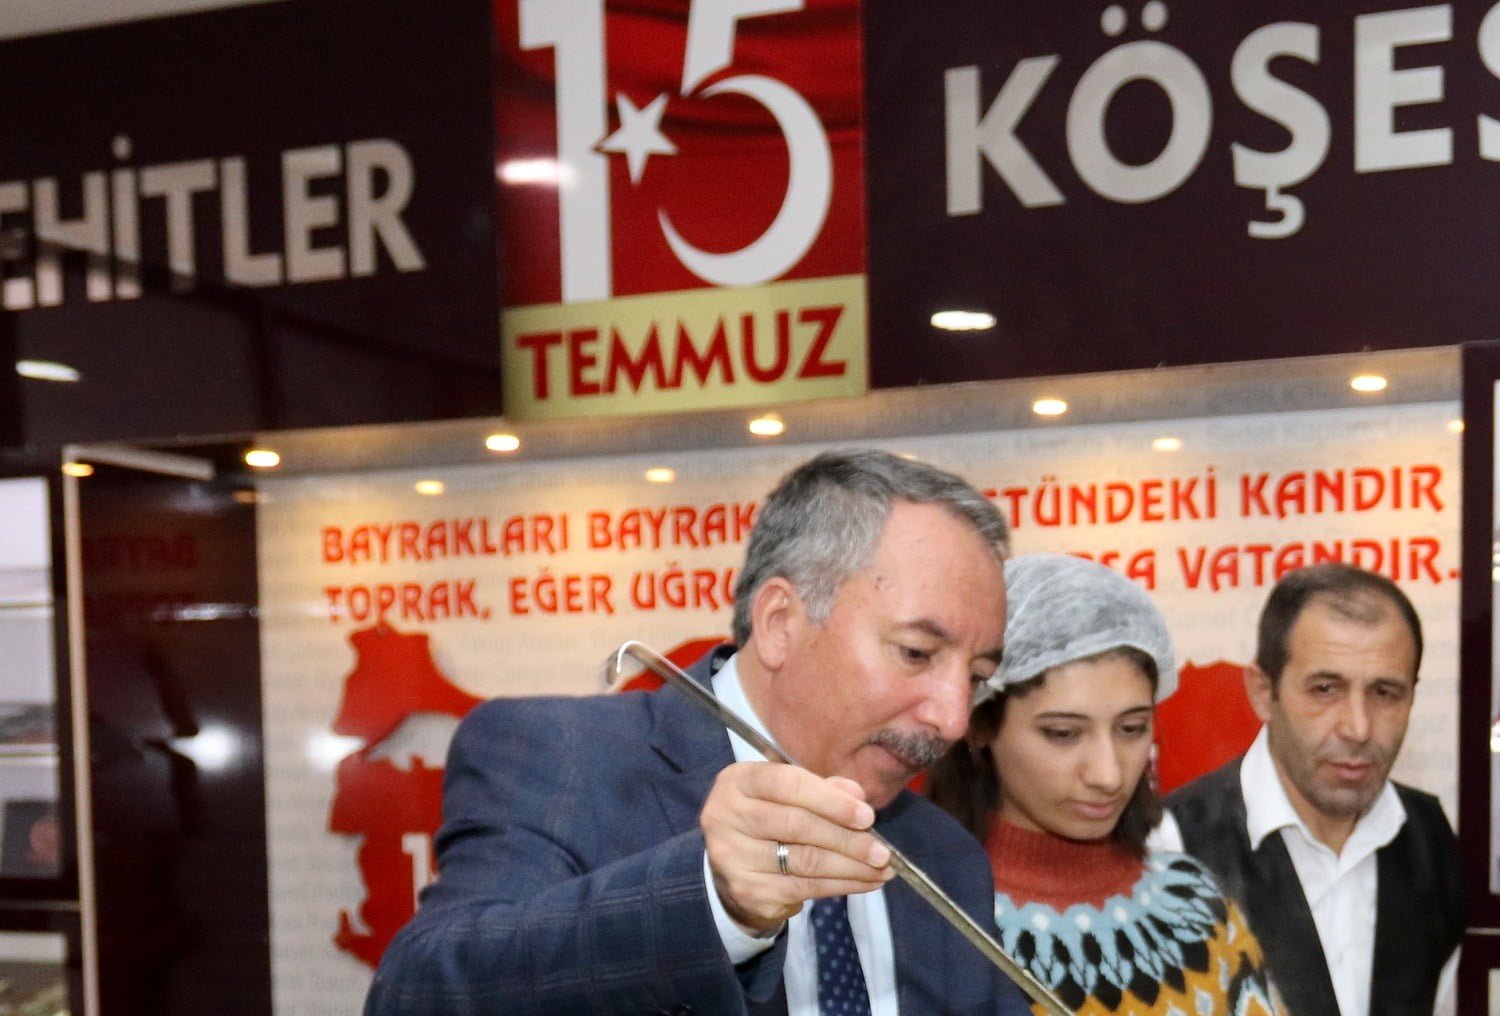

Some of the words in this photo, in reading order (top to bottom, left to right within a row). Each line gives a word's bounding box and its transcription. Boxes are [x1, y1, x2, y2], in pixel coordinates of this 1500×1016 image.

[517, 306, 847, 399] TEMMUZ
[321, 513, 569, 564] BAYRAKLARI
[984, 476, 1217, 529] TÜNDEKİ
[1241, 464, 1444, 519] KANDIR
[508, 568, 615, 616] EĞER
